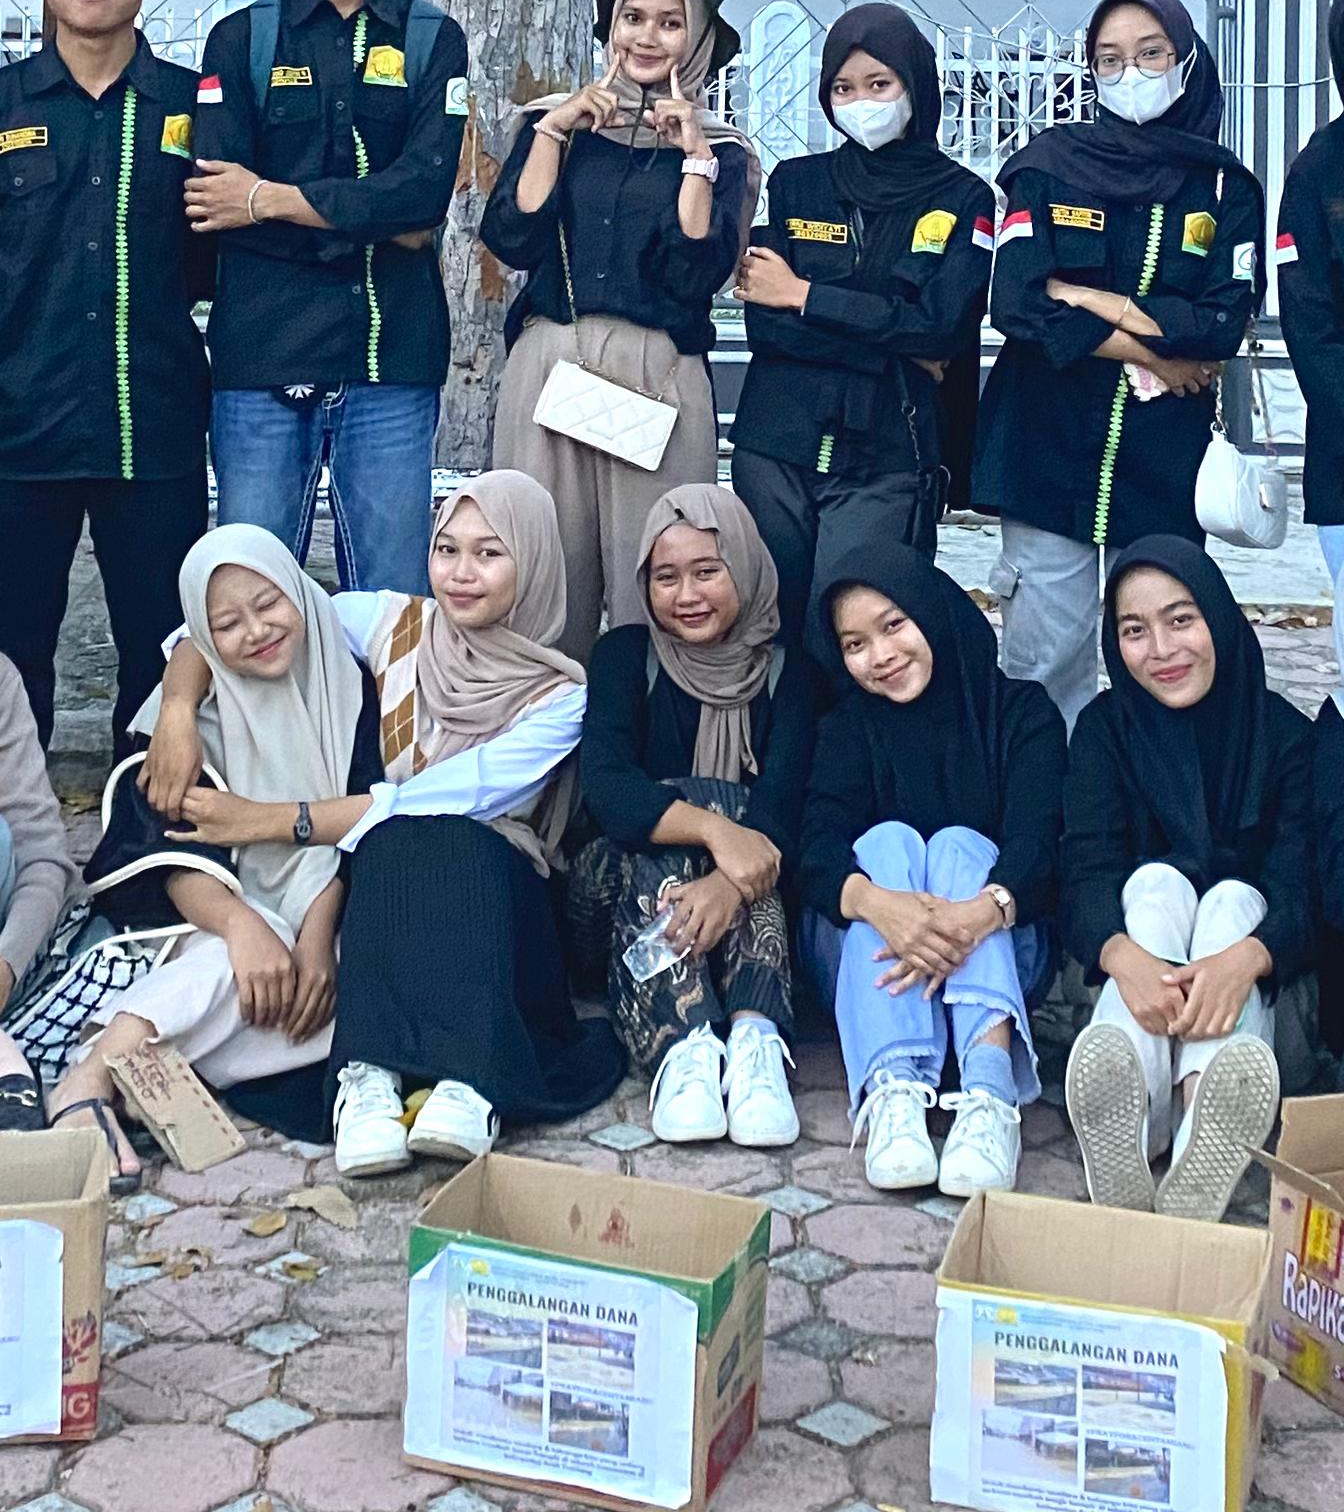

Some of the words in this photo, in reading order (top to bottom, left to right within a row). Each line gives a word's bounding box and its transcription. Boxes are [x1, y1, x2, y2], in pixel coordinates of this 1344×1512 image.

[467, 1281, 590, 1319] PENGGALANGAN
[596, 1306, 639, 1327] DANA
[994, 1331, 1127, 1364] PENGGALANGAN
[1133, 1350, 1179, 1369] DANA
